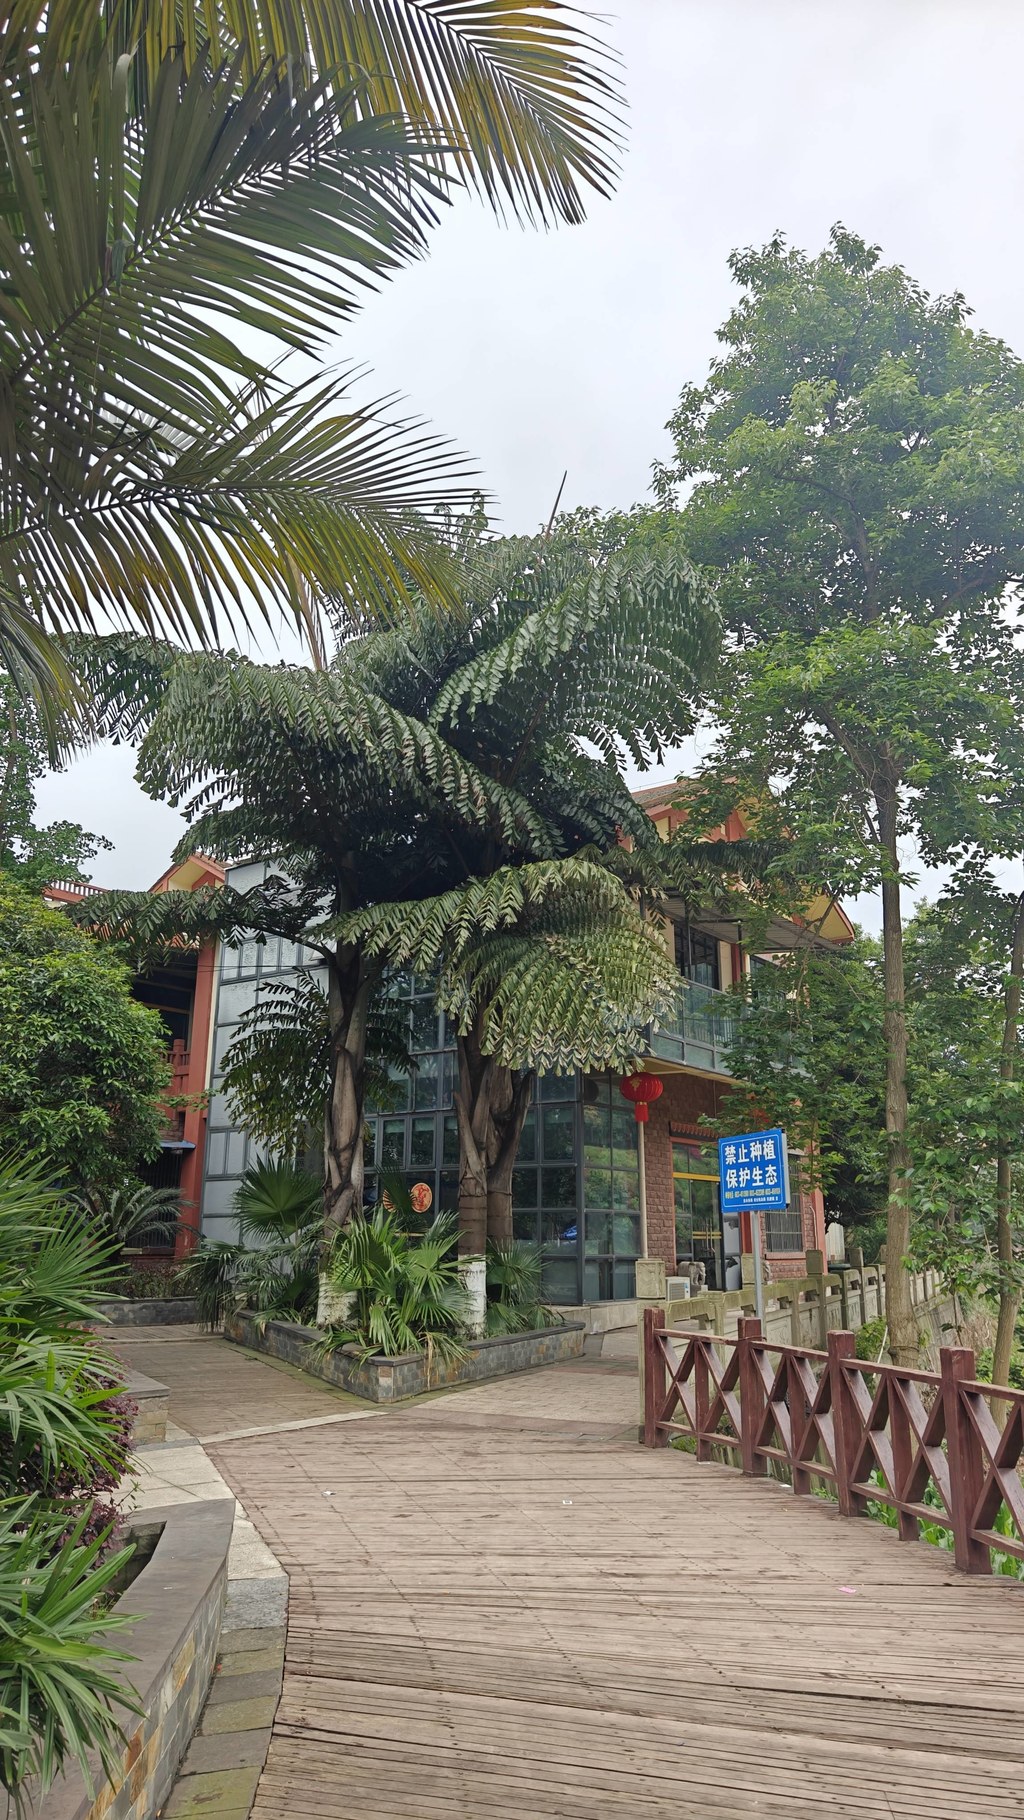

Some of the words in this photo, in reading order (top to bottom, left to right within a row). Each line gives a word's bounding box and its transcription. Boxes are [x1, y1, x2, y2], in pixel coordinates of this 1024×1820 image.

[724, 1138, 776, 1165] 禁止种植
[726, 1164, 777, 1189] 保护生态
